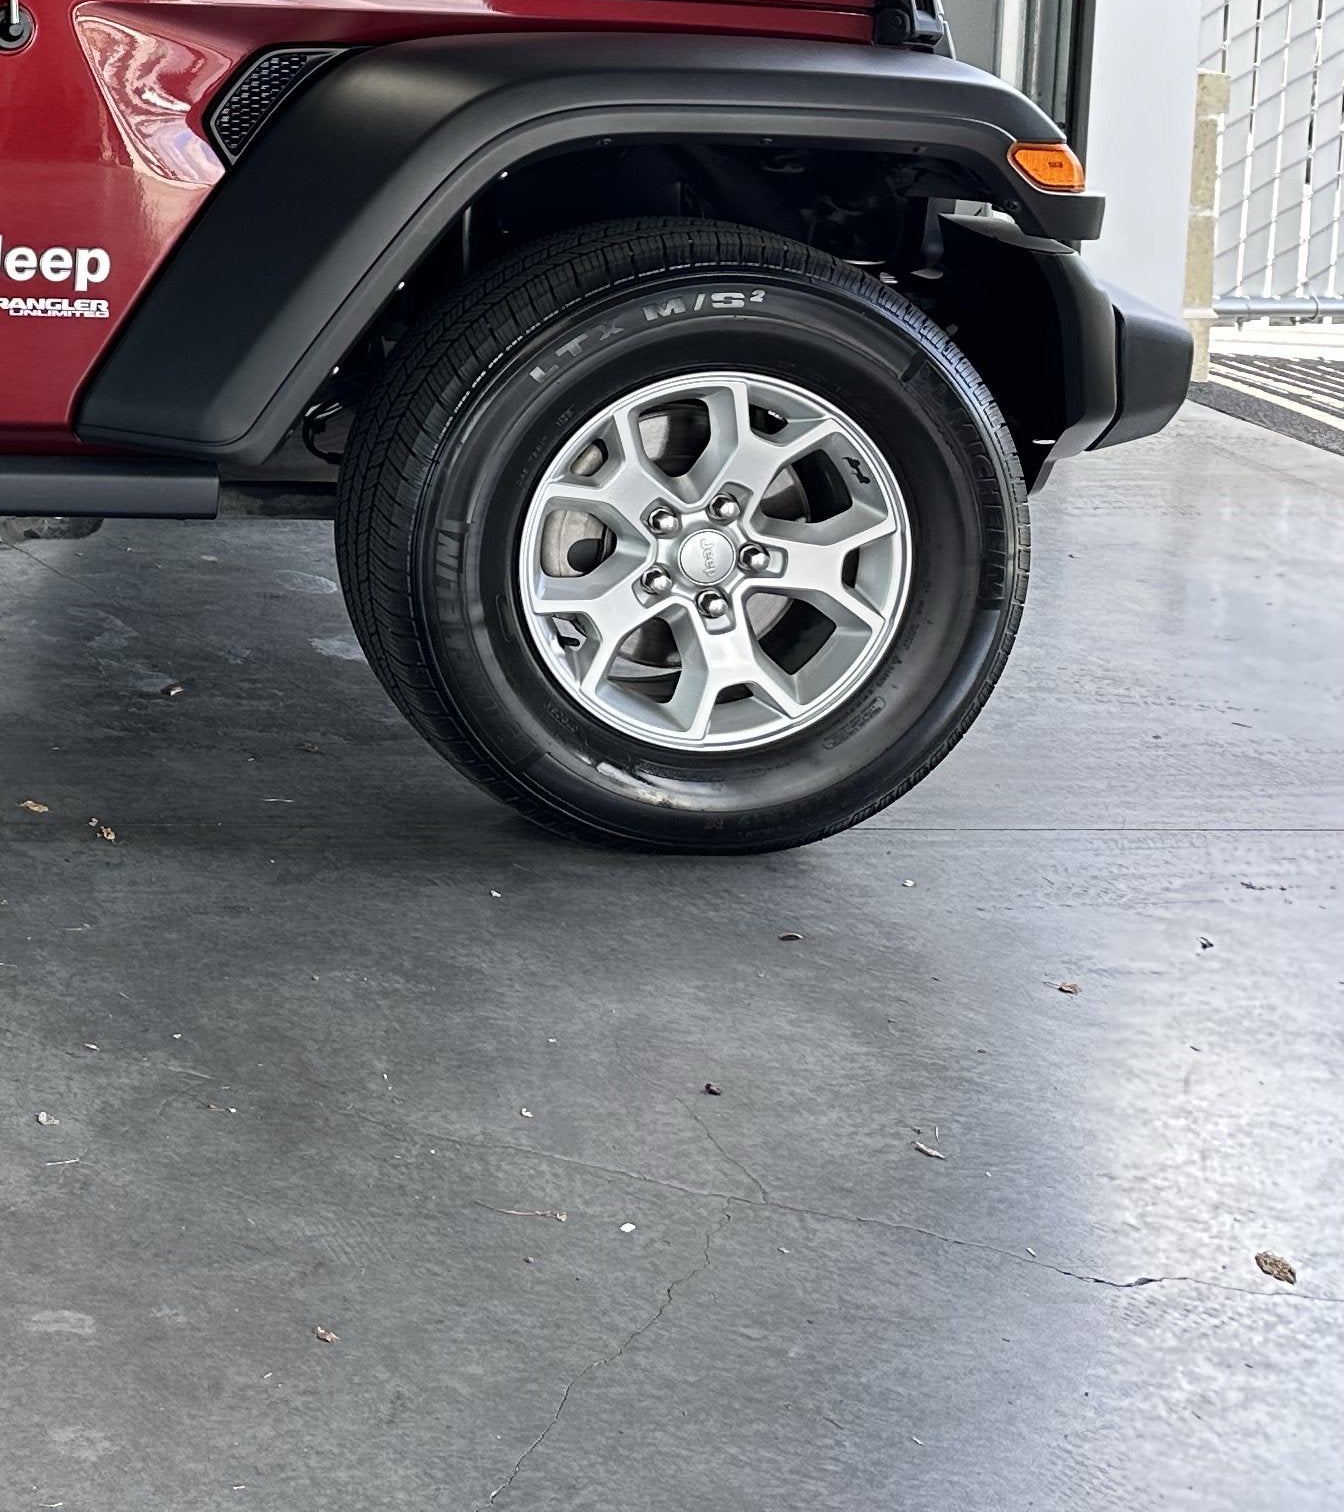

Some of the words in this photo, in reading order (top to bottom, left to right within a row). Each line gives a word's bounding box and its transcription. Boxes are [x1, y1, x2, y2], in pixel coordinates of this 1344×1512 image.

[8, 309, 110, 318] UNLIMITED
[529, 316, 625, 384] LTX
[699, 538, 717, 577] Jeep
